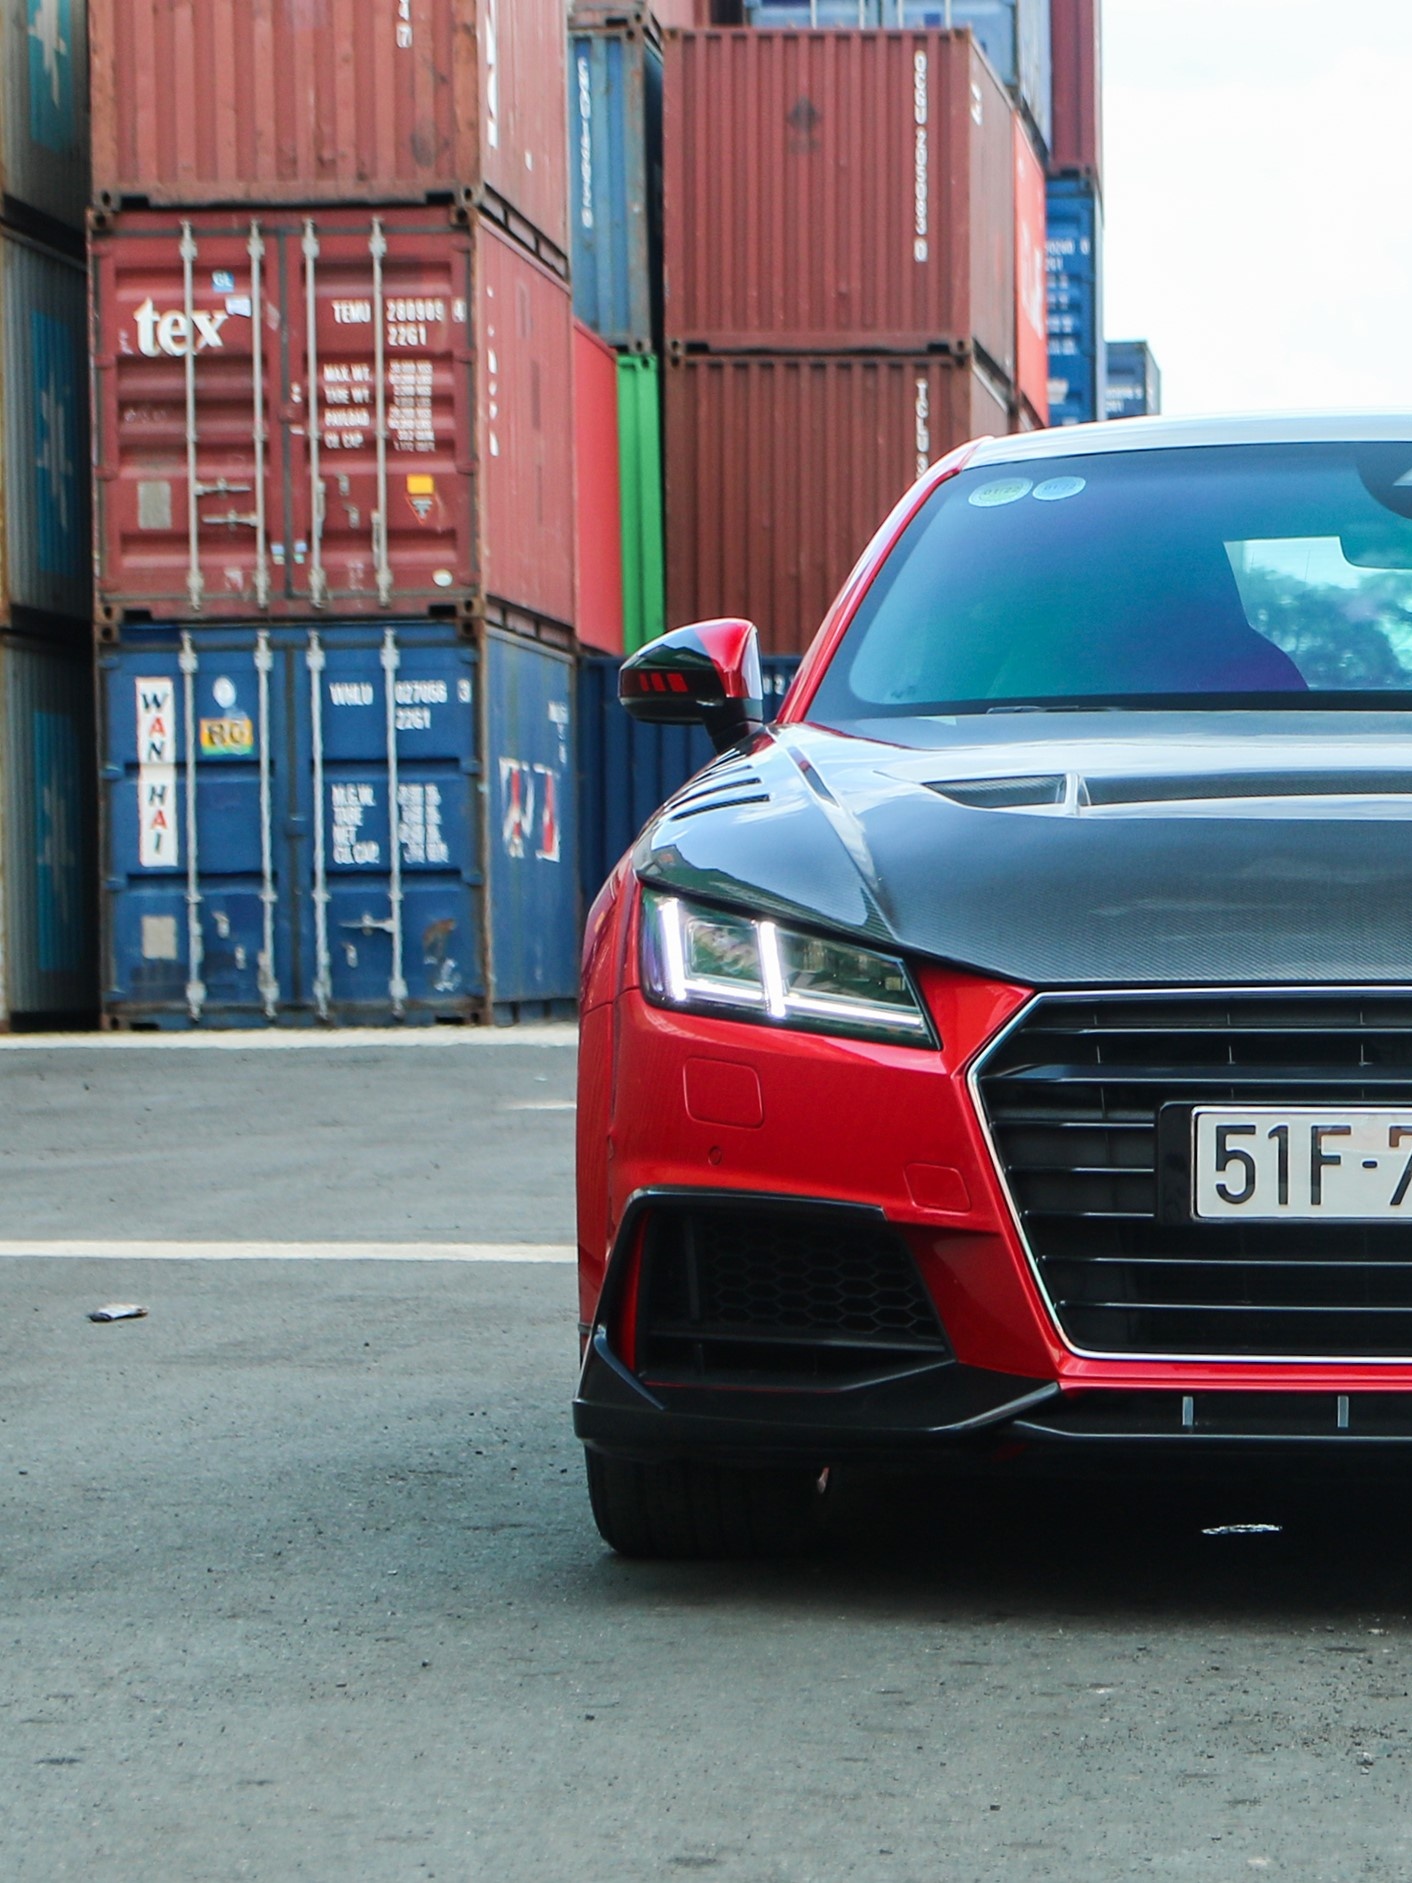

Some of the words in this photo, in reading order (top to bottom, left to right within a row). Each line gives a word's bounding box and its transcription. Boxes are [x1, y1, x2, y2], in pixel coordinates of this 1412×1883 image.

[133, 296, 229, 357] tex
[332, 300, 371, 323] TEMU
[387, 323, 426, 346] 22G1
[141, 692, 168, 762] WAN
[149, 784, 167, 855] HAI
